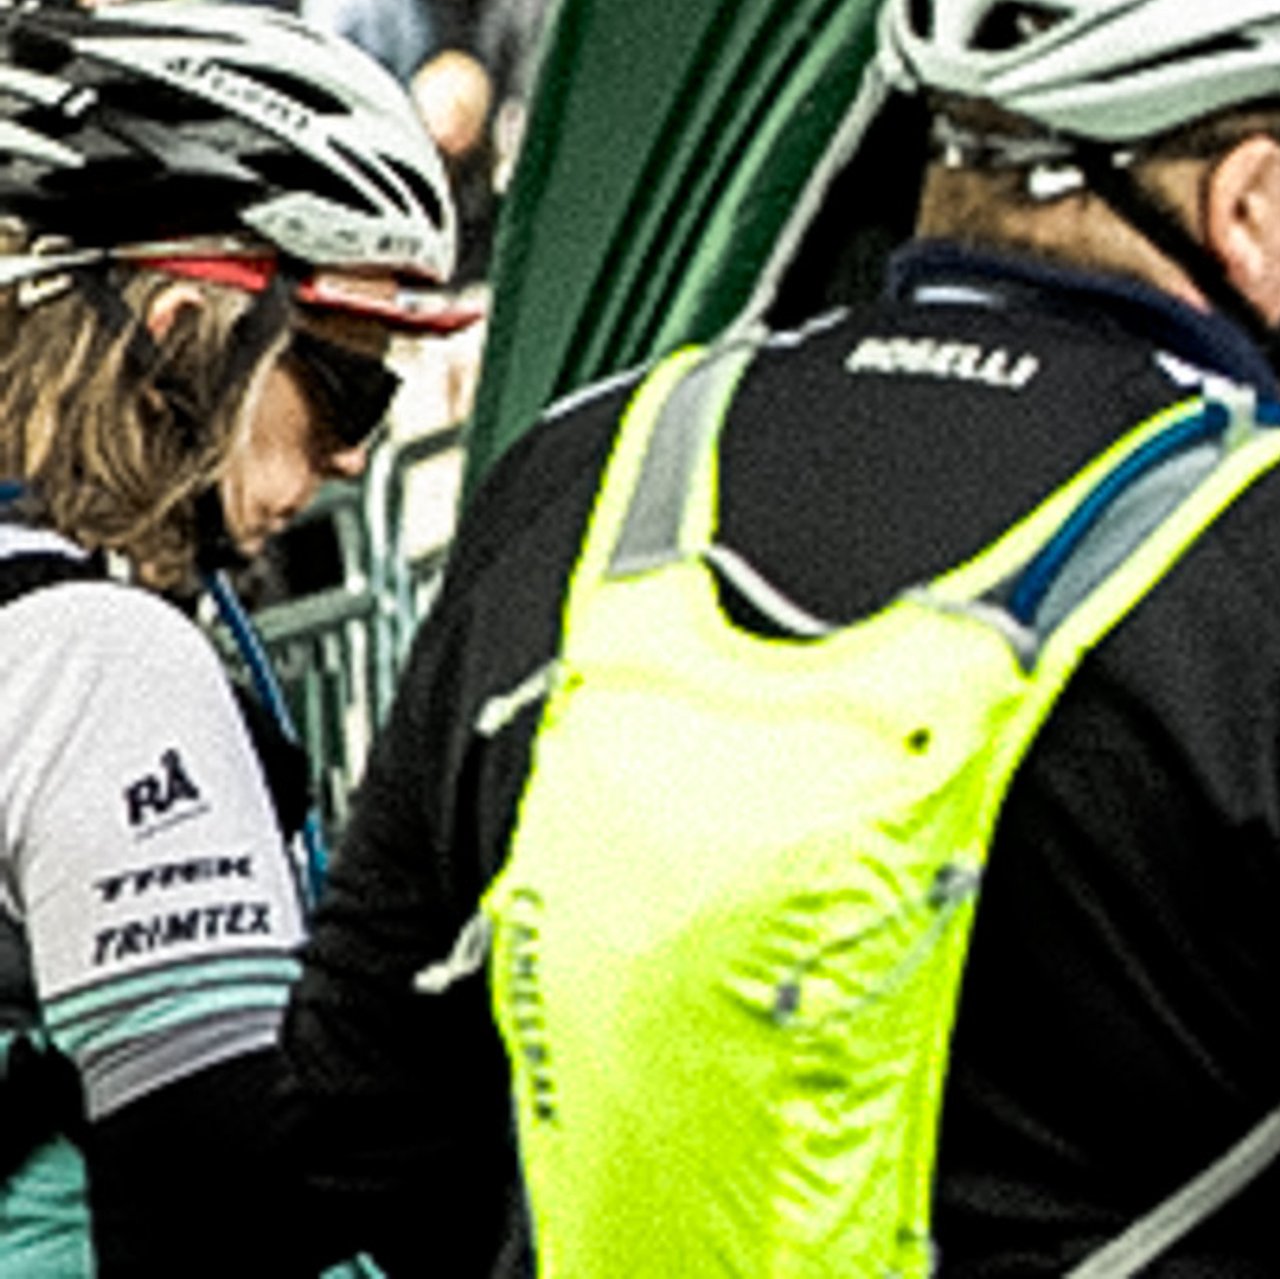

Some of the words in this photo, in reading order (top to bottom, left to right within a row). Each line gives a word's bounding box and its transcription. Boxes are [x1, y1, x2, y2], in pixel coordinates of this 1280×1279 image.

[124, 748, 200, 826] RÅ
[94, 855, 252, 904] TREK
[94, 902, 271, 966] TRIMTEX
